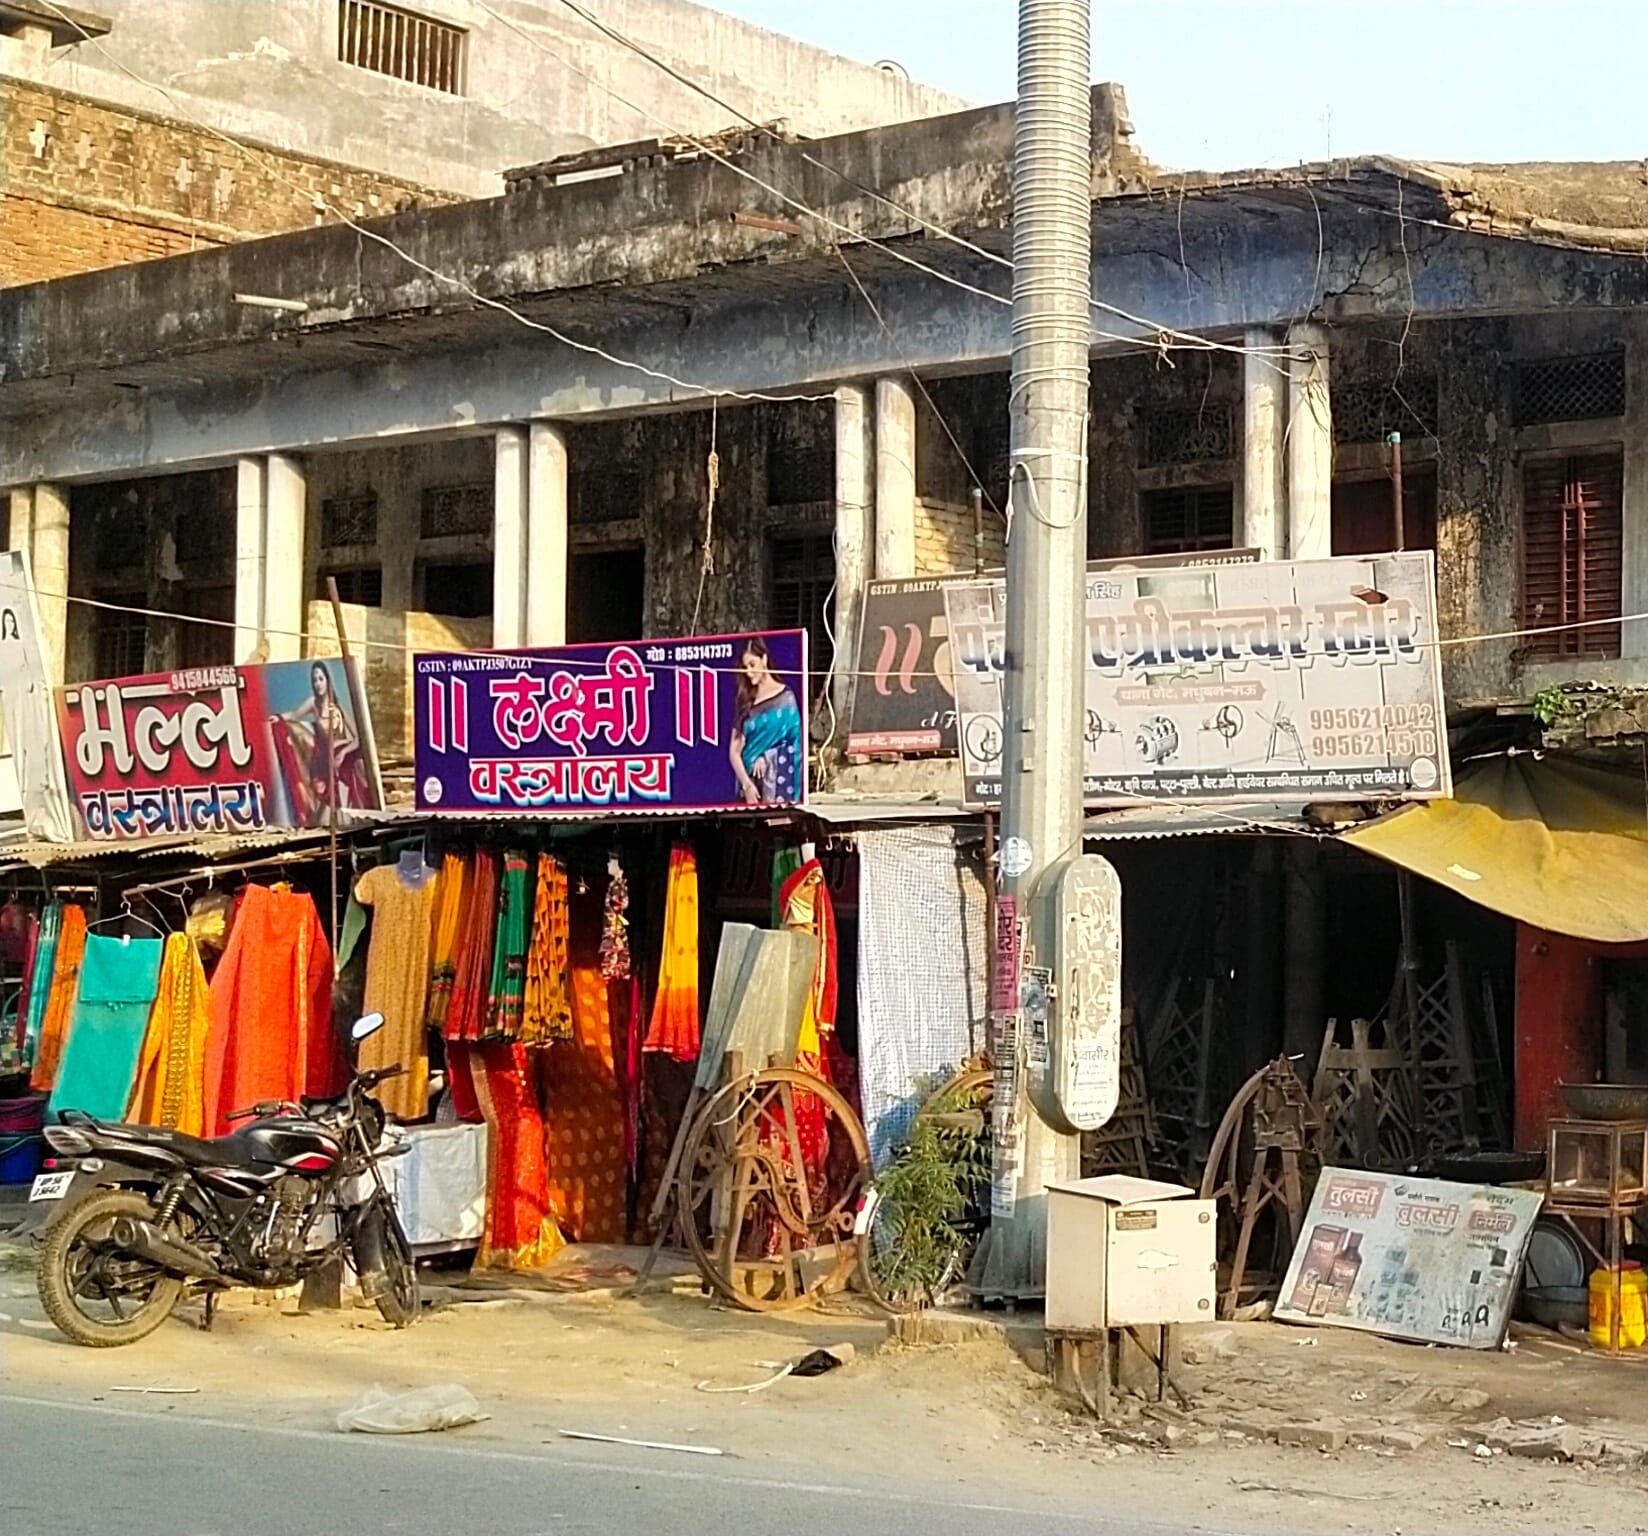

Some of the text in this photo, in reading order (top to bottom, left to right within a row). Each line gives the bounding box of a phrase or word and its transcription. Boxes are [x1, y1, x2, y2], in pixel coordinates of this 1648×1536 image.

[489, 645, 655, 757] लक्ष्मी
[1310, 704, 1434, 730] 9956214042
[66, 682, 253, 777] मल्ल
[1312, 731, 1437, 757] 9956214518
[468, 753, 676, 806] वस्त्रालय
[81, 782, 267, 837] वस्त्रालय
[1328, 1184, 1380, 1208] तुलसी
